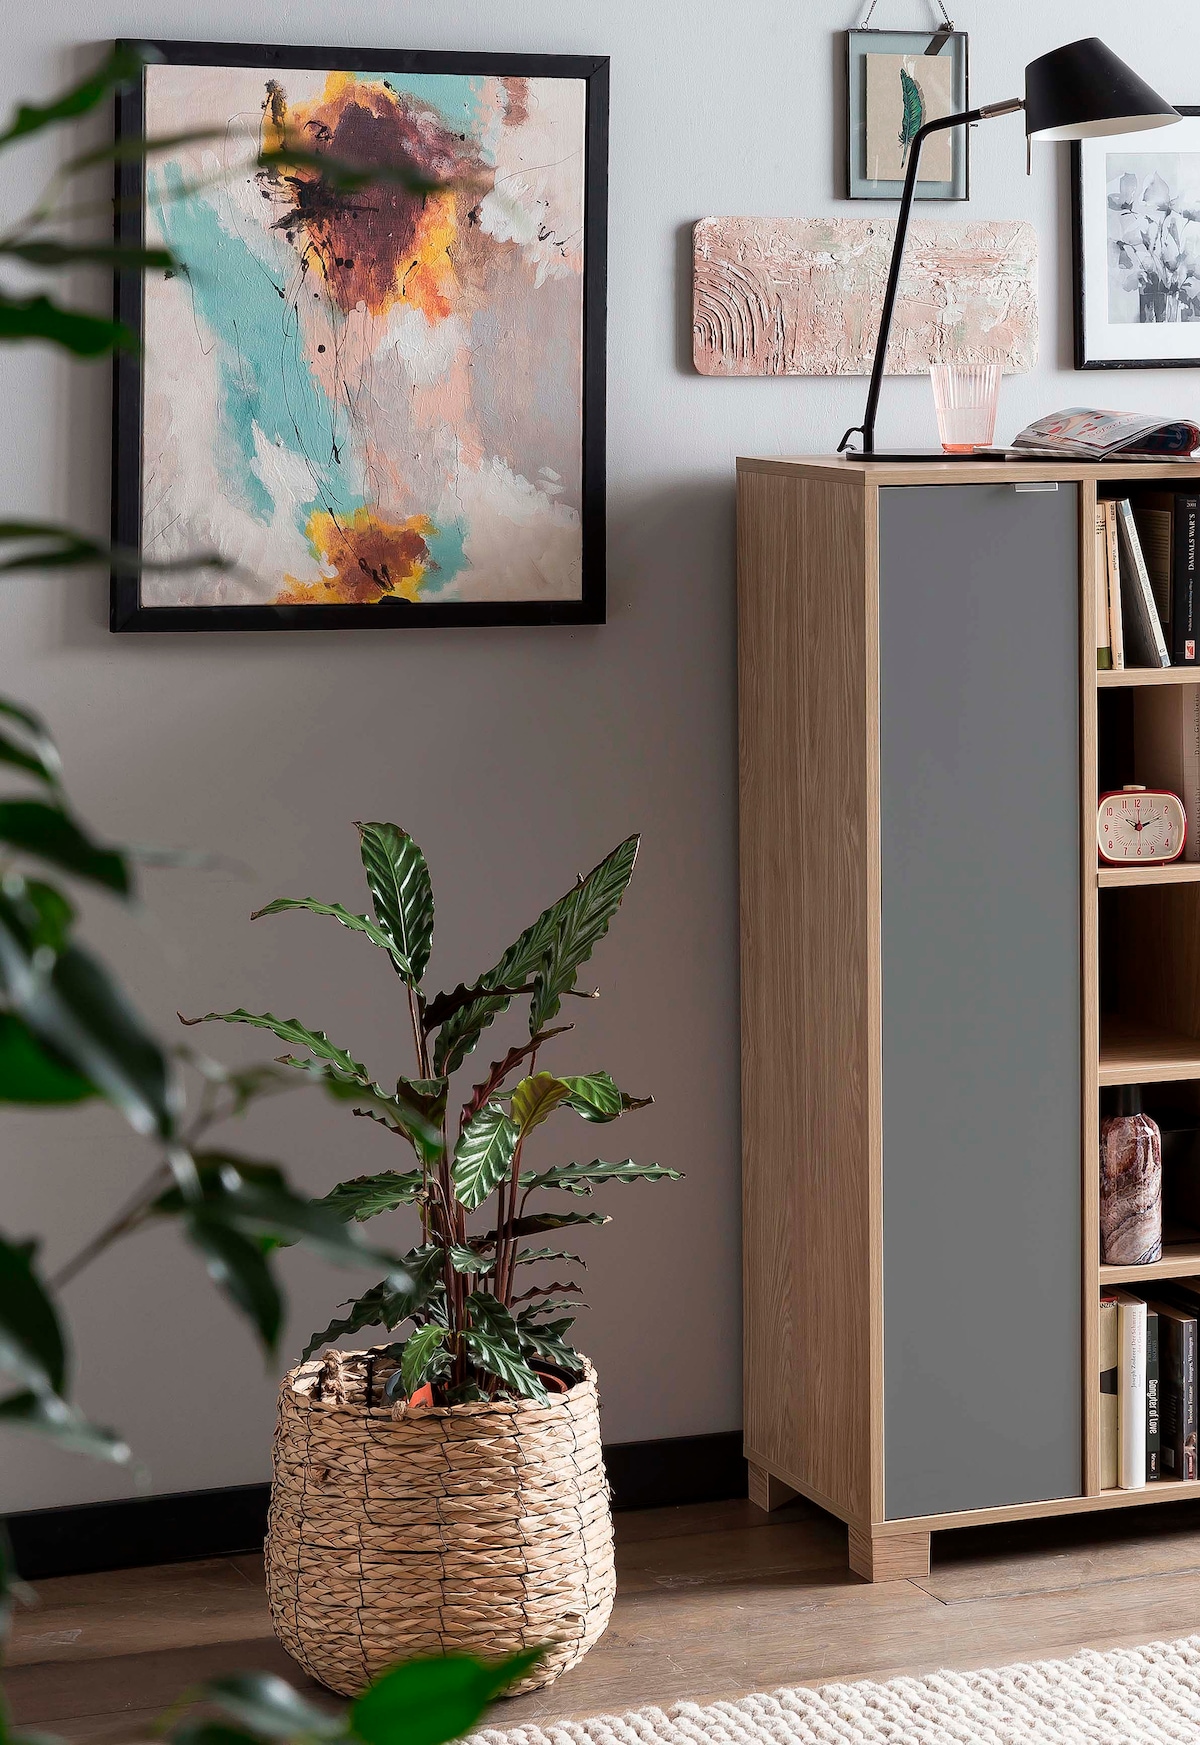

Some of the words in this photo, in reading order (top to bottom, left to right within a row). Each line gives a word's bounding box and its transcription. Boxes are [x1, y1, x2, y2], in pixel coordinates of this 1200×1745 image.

[1188, 513, 1196, 539] WAR'S
[1122, 800, 1127, 808] 11
[1134, 799, 1141, 807] 12
[1106, 807, 1113, 816] 10
[1104, 824, 1109, 832] 9
[1168, 822, 1172, 830] 3
[1108, 841, 1113, 849] 8
[1164, 839, 1169, 847] 4
[1137, 847, 1142, 855] 6
[1146, 1379, 1158, 1409] Gangster
[1149, 1409, 1159, 1418] of
[1149, 1418, 1158, 1434] Love
